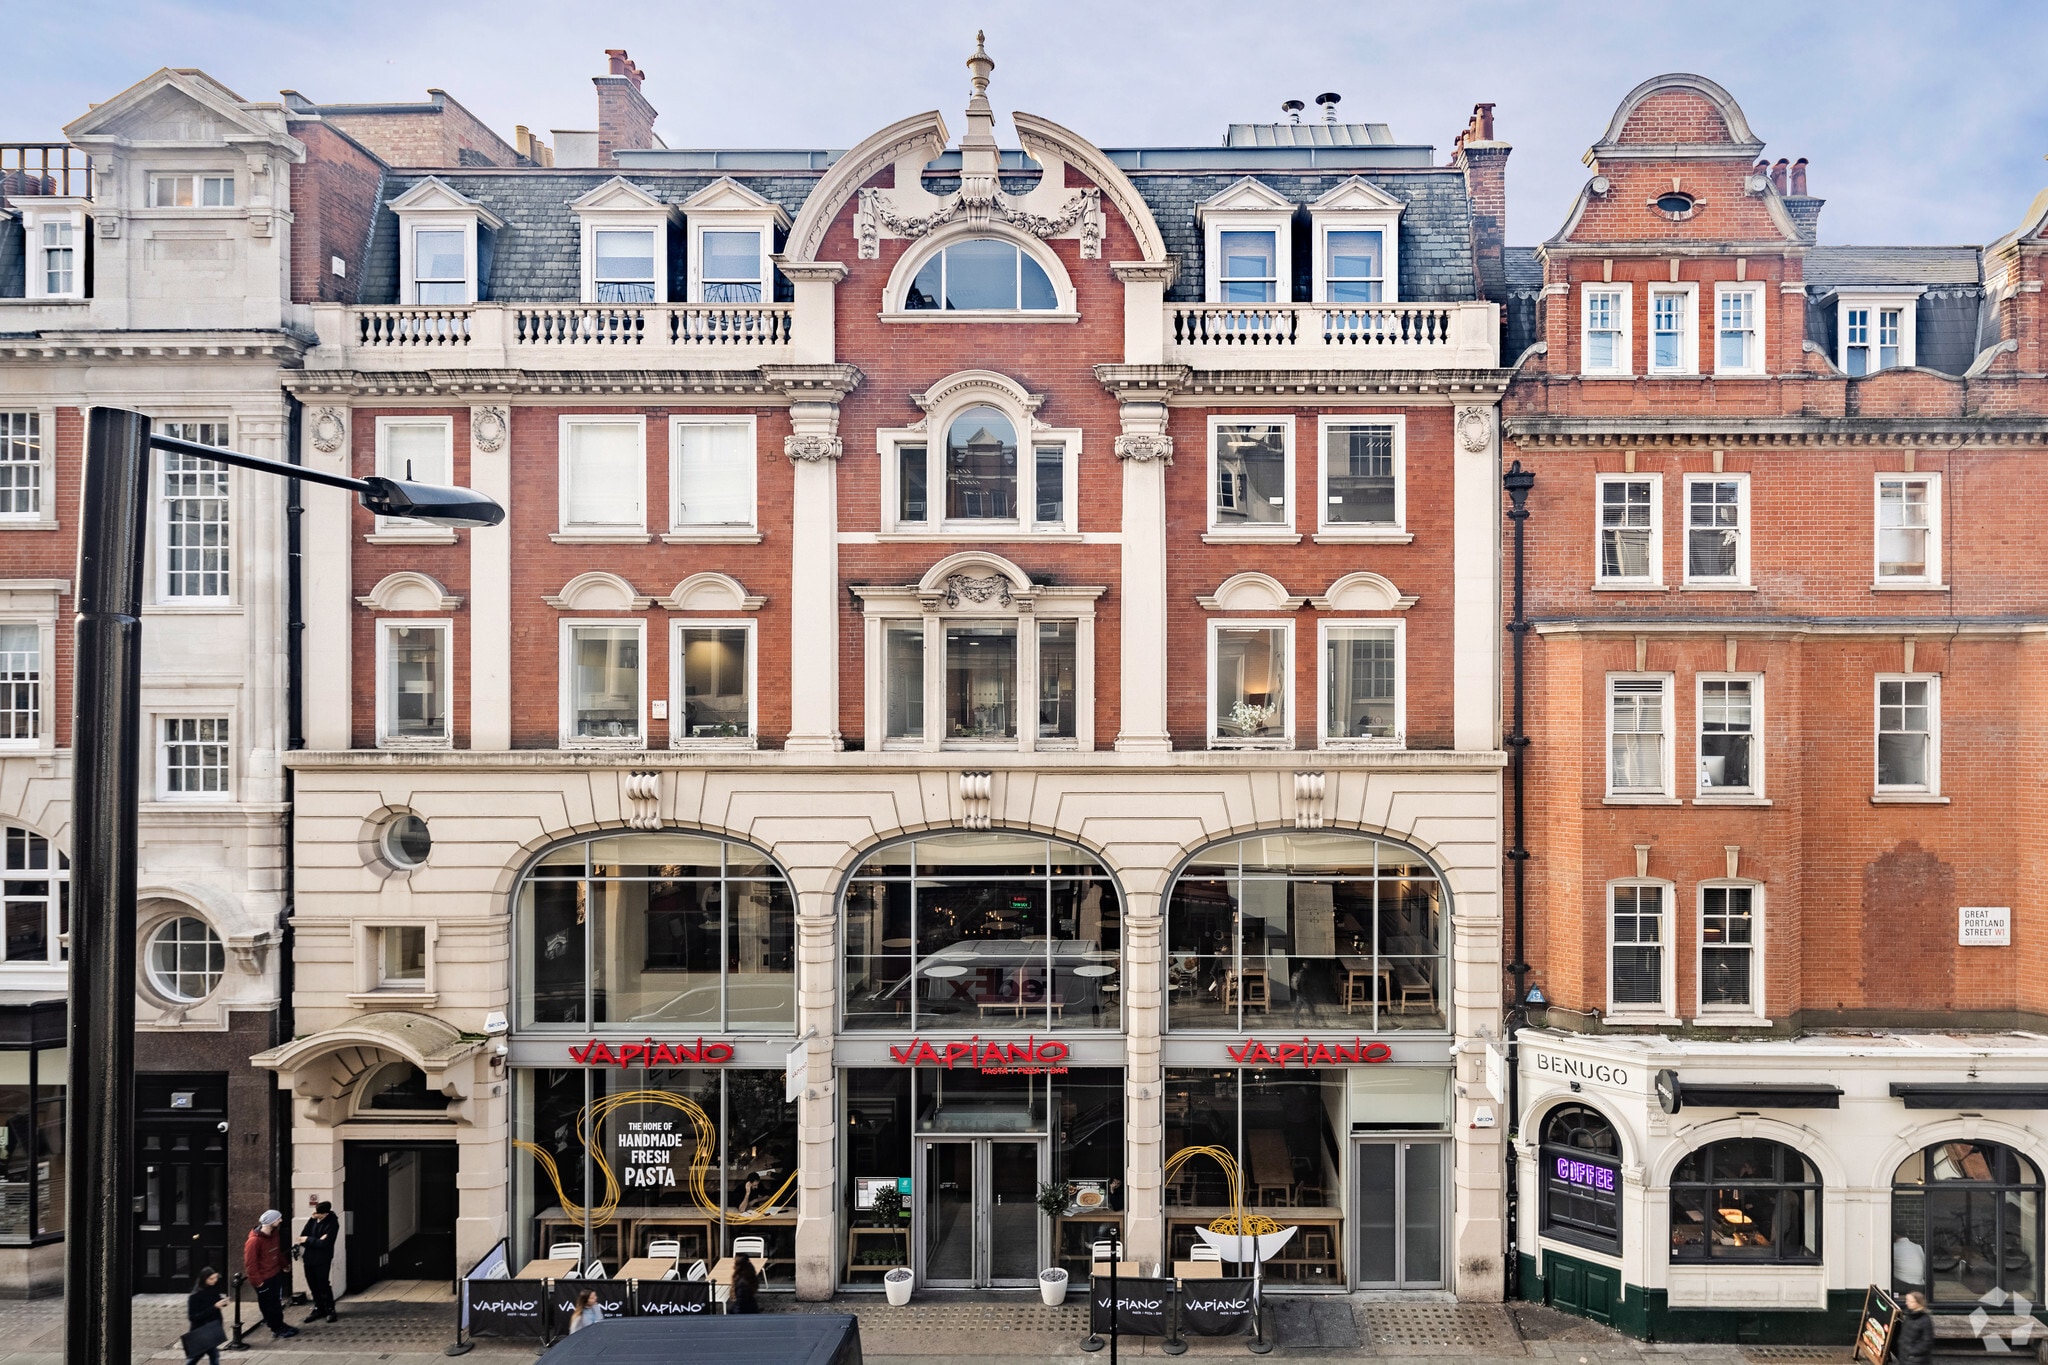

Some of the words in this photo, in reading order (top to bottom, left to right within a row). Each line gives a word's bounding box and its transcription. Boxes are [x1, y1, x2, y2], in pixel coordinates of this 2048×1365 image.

[1964, 910, 1989, 918] GREAT
[1964, 919, 2005, 927] PORTLAND
[1964, 928, 1992, 936] STREET
[1994, 928, 2005, 936] W1
[981, 1067, 1008, 1075] PASTA
[1017, 1067, 1041, 1075] PIZZA
[1537, 1053, 1628, 1085] BENUGO
[628, 1122, 642, 1131] THE
[643, 1122, 662, 1131] HOME
[663, 1122, 673, 1131] OF
[243, 1132, 259, 1145] 17
[618, 1133, 683, 1147] HANDMADE
[631, 1150, 670, 1164] FRESH
[624, 1166, 676, 1187] PASTA
[1557, 1157, 1613, 1191] COFFEE
